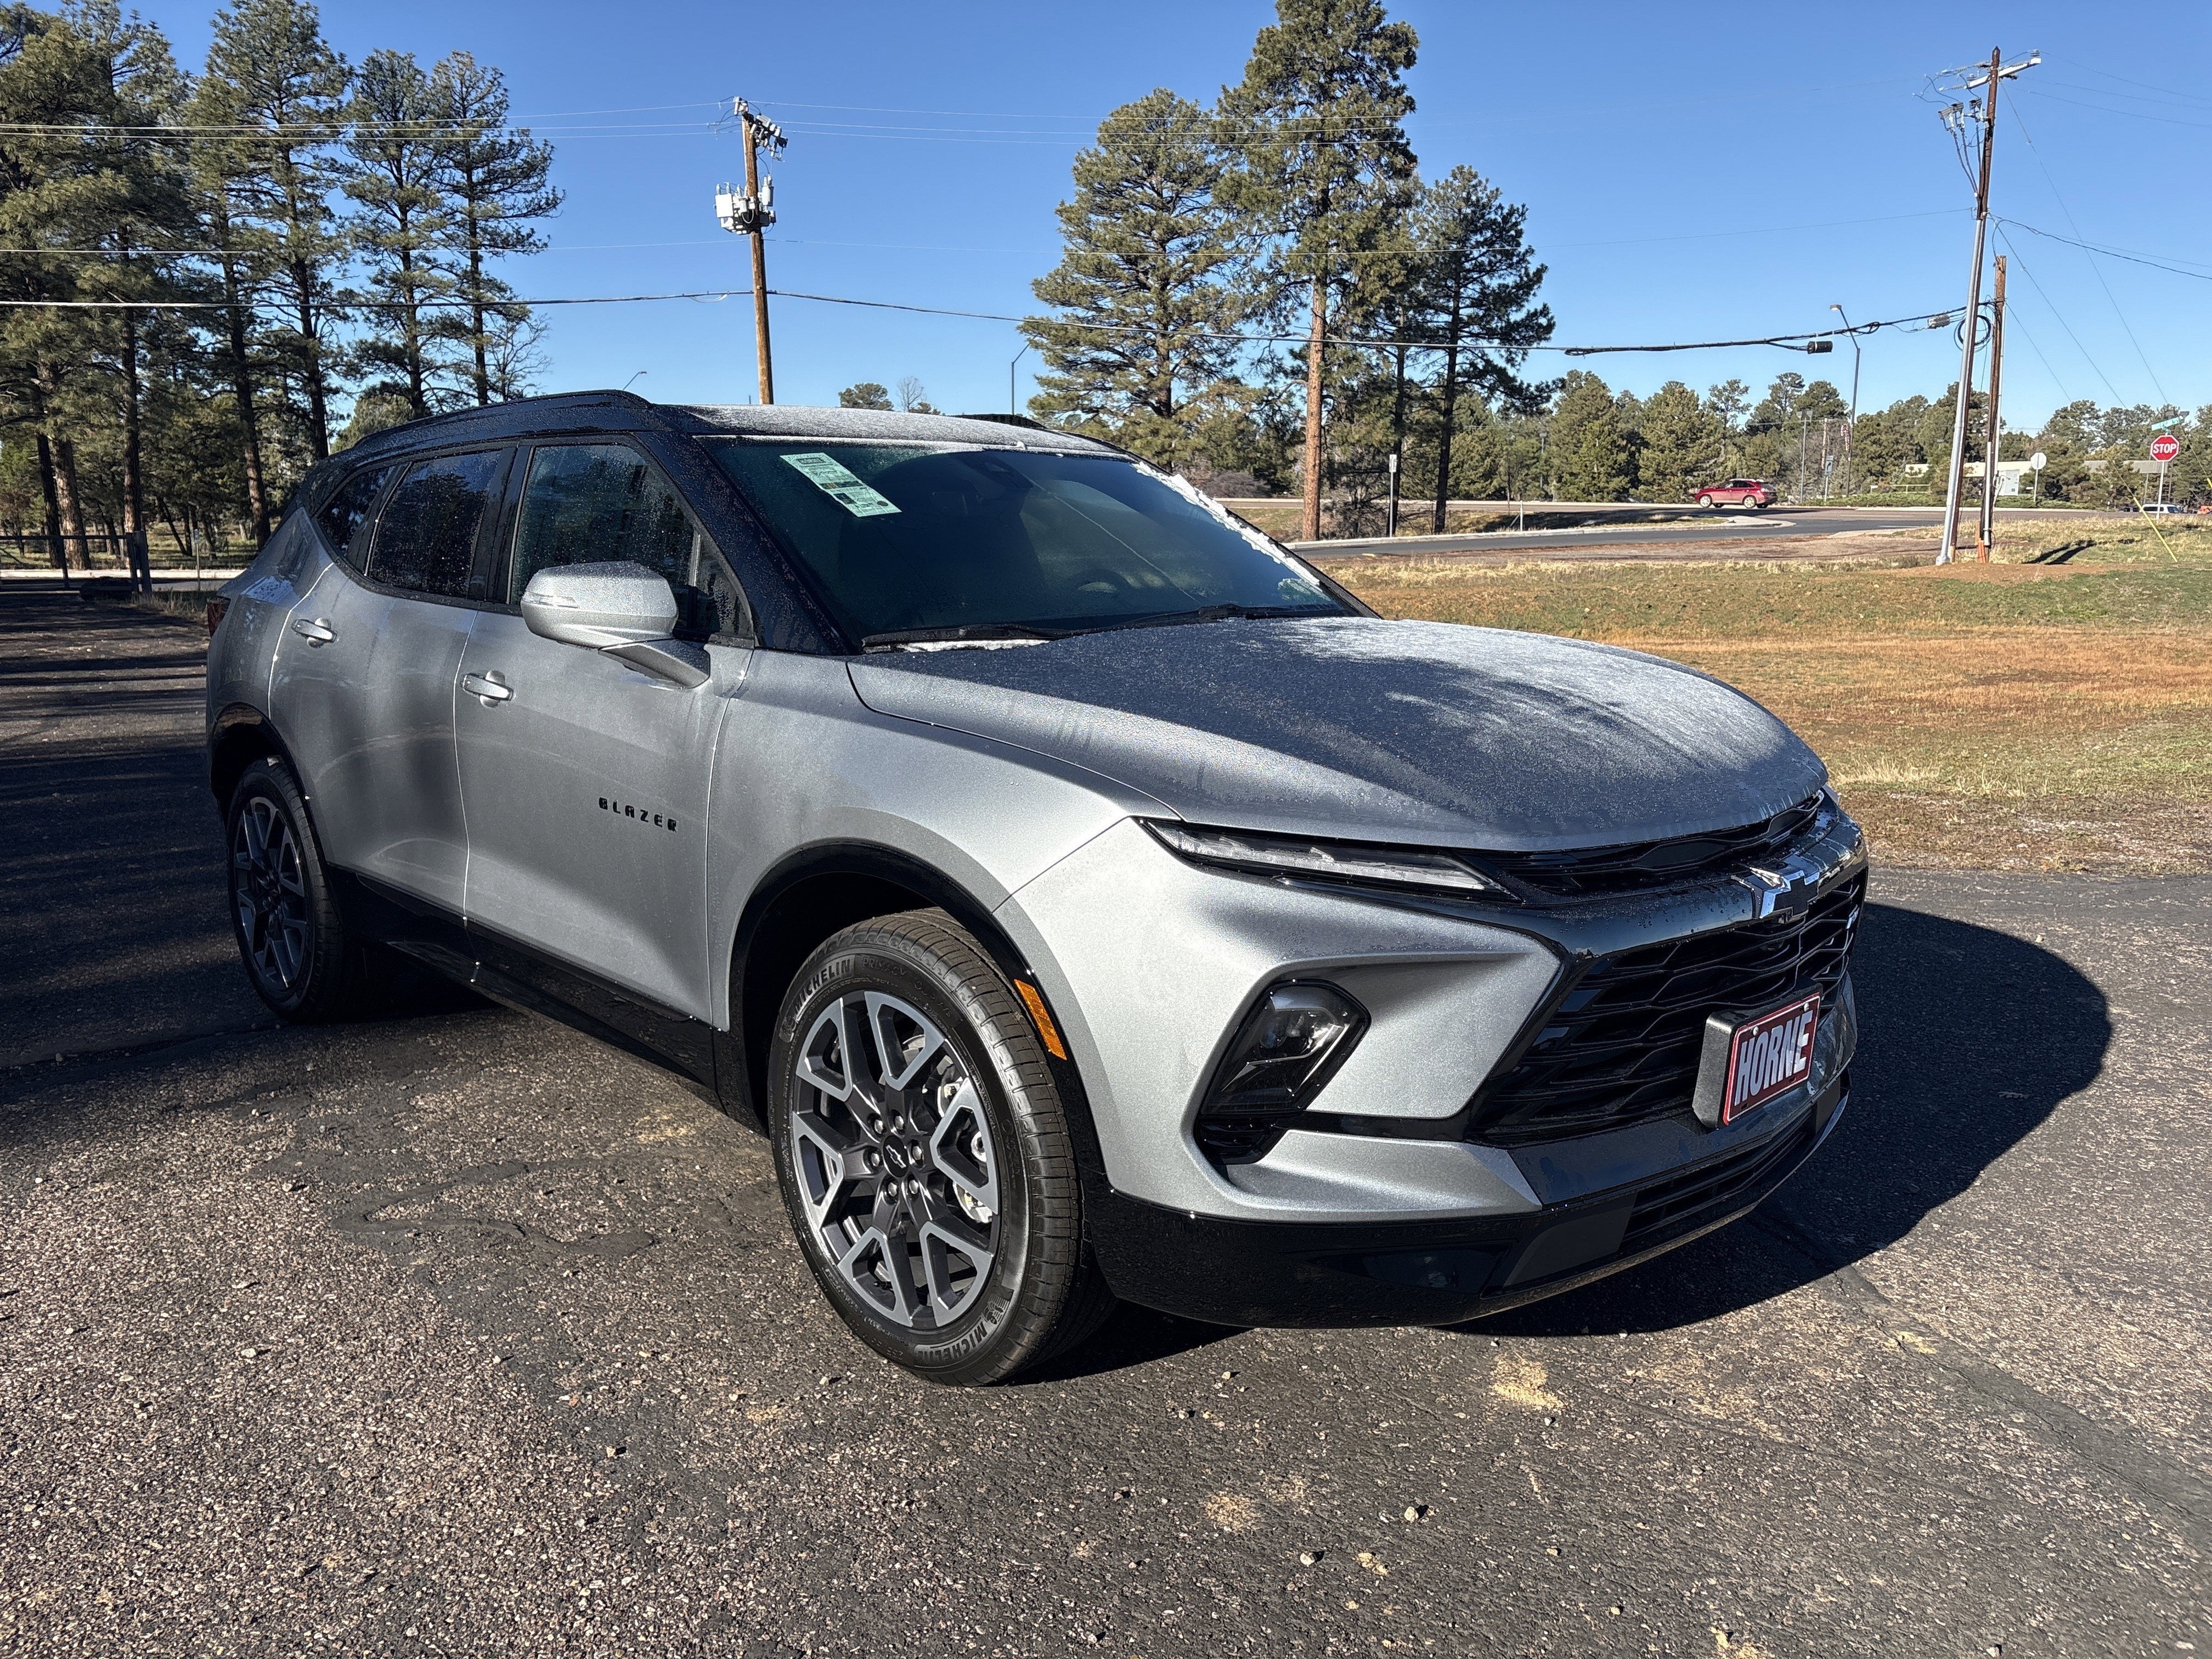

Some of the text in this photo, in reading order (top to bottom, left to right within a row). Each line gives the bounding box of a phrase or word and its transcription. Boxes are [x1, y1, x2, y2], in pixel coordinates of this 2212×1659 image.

[2153, 443, 2177, 454] STOP
[599, 797, 677, 833] BLAZER
[793, 958, 850, 1013] MICHELIN
[1734, 1010, 1813, 1107] HORNE
[918, 1322, 988, 1362] MICHELIN
